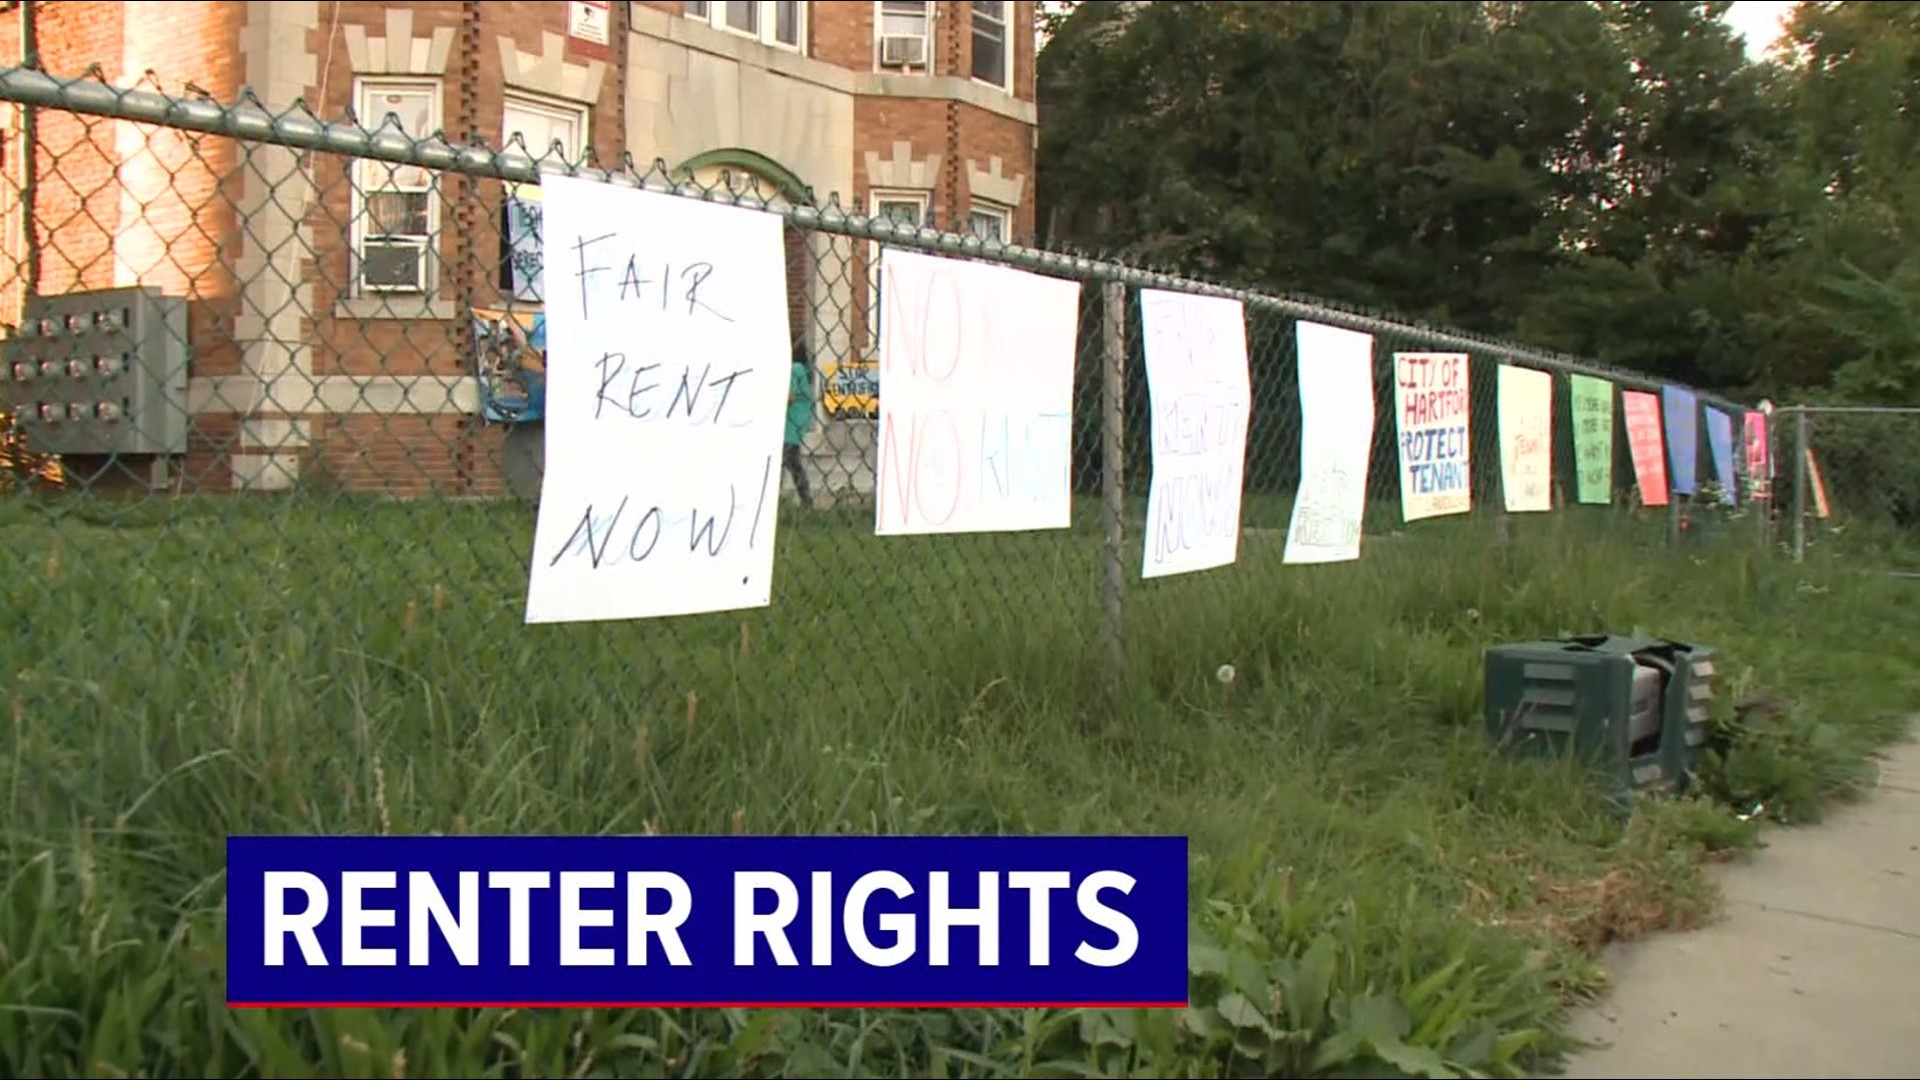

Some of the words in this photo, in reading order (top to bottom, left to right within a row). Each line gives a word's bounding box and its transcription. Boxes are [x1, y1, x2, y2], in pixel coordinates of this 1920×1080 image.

[571, 232, 735, 323] FAIR
[886, 263, 962, 382] NO
[595, 351, 754, 424] RENT
[1398, 357, 1437, 388] CITY
[1442, 357, 1459, 388] OF
[549, 454, 771, 586] NOW!
[877, 409, 962, 531] NO
